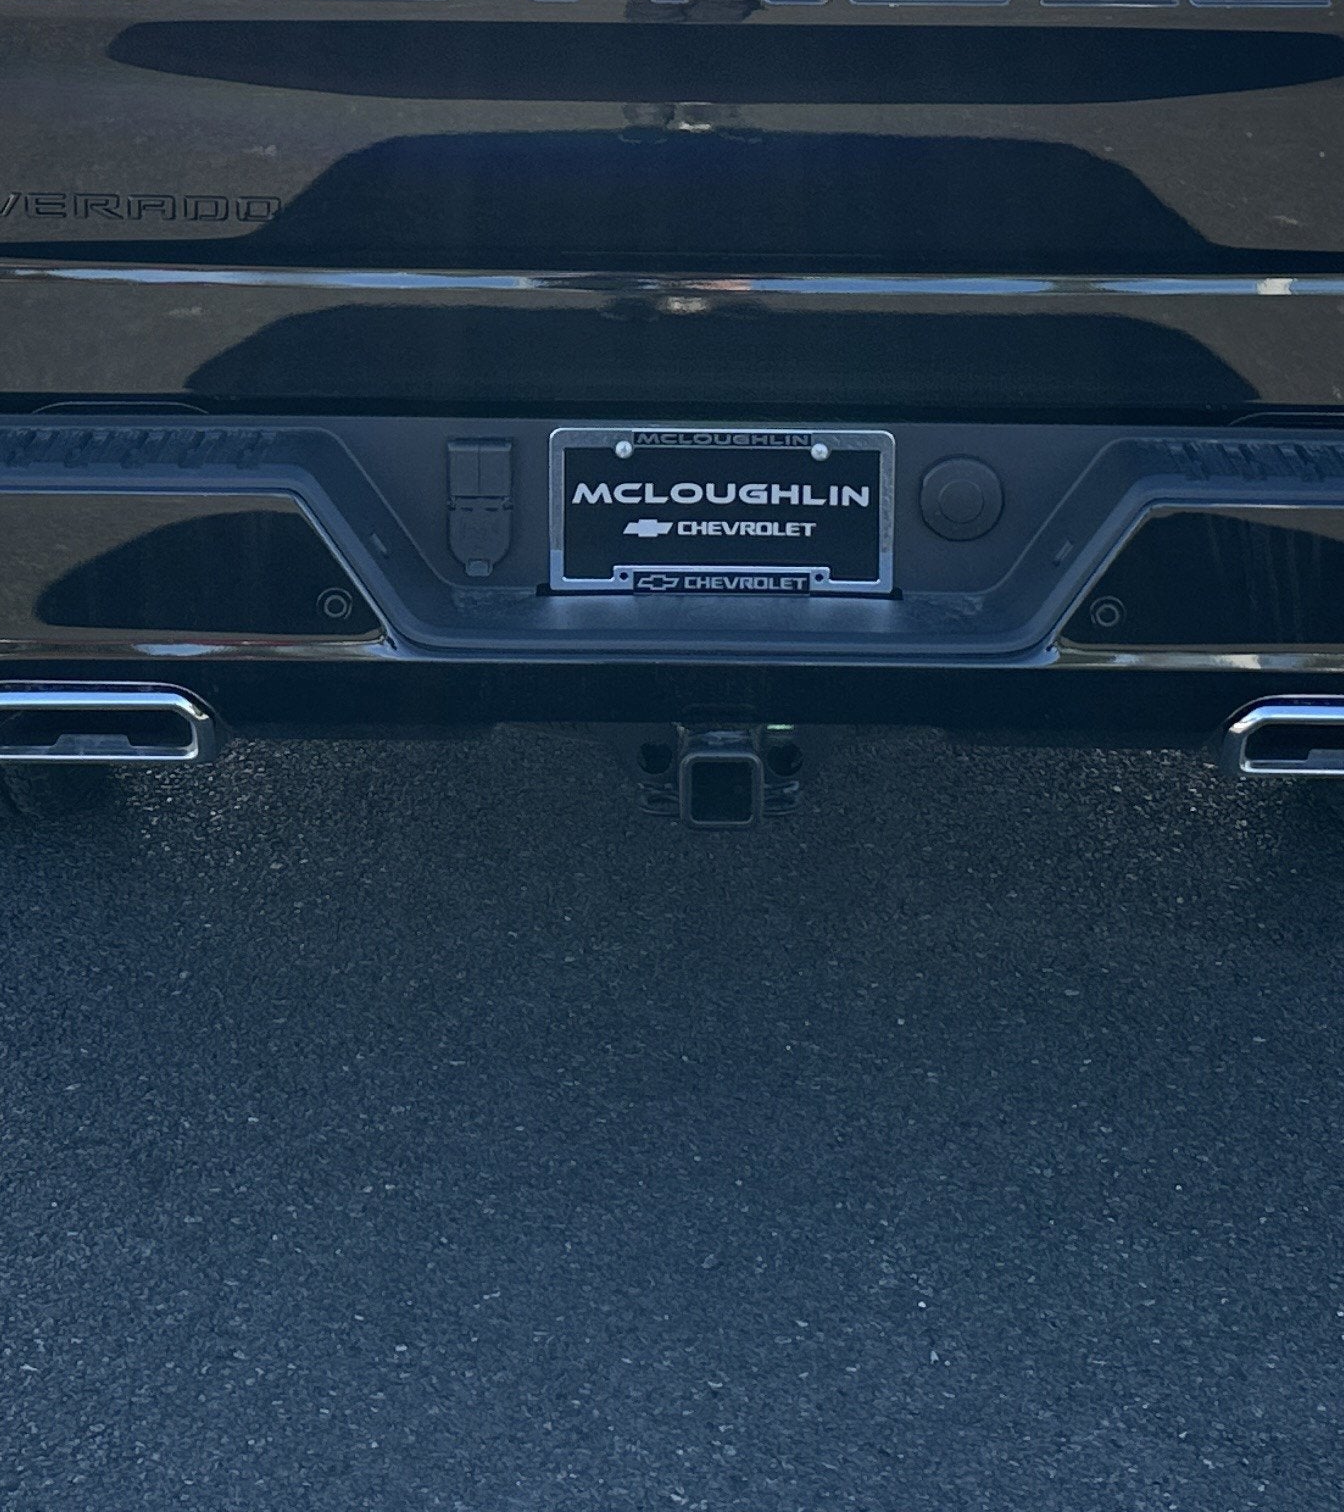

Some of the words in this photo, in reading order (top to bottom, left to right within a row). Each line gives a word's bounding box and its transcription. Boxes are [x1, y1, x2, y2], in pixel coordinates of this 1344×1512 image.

[636, 432, 810, 447] MCLOUGHLIN
[571, 482, 871, 508] MCLOUGHLIN
[677, 521, 817, 537] CHEVROLET
[683, 576, 807, 591] CHEVROLET
